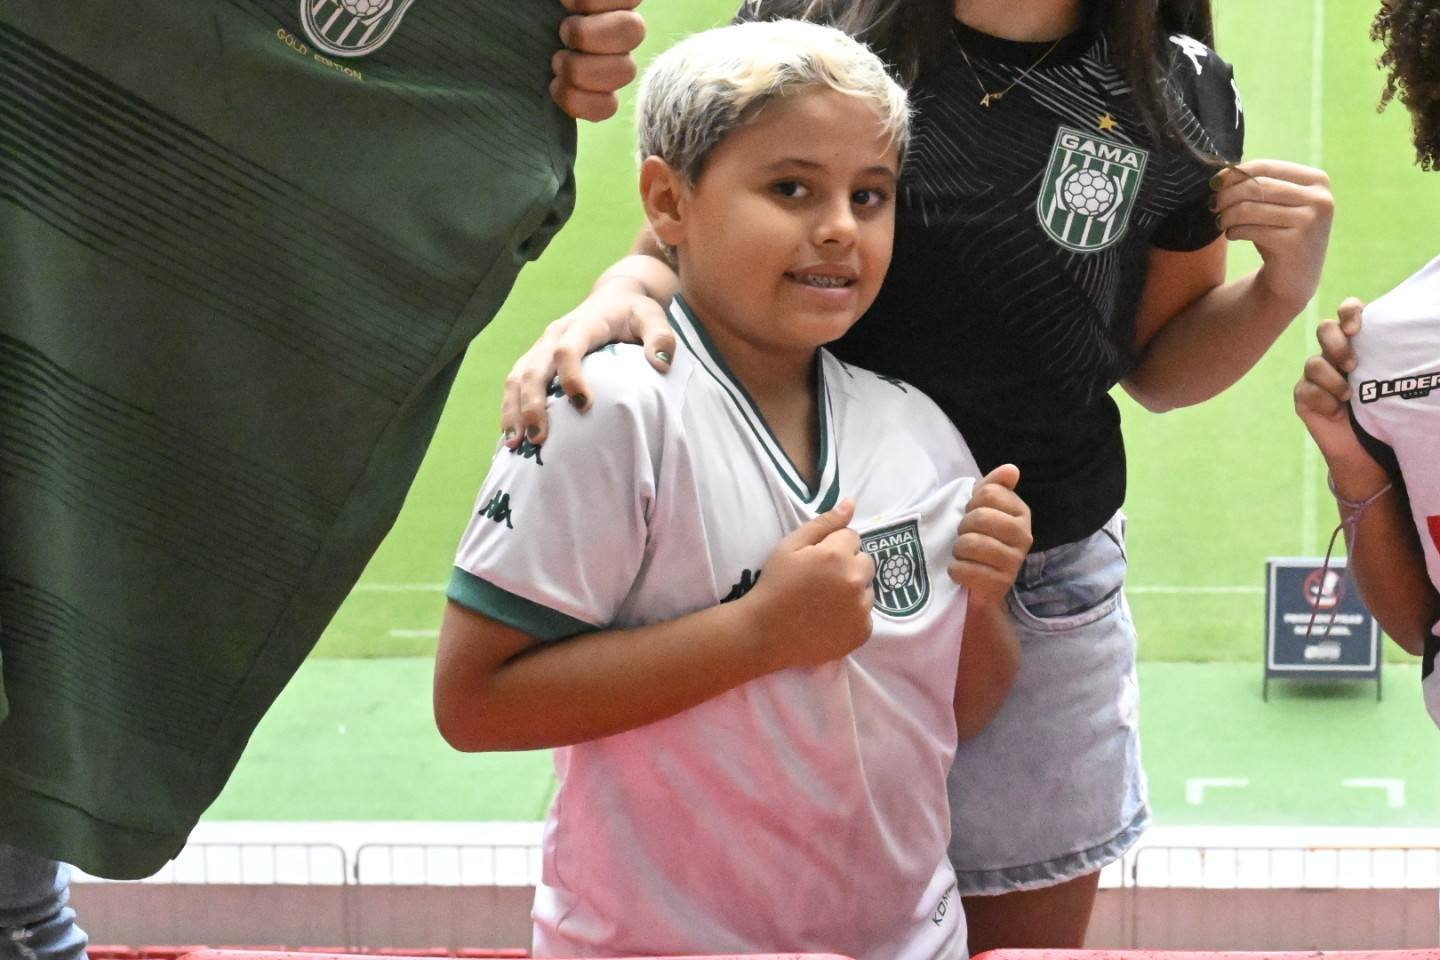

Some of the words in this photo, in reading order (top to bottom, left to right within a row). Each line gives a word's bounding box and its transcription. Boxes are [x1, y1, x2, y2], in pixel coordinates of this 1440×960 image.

[275, 26, 308, 56] GOLD
[1060, 132, 1140, 169] GAMA
[865, 531, 914, 553] GAMA
